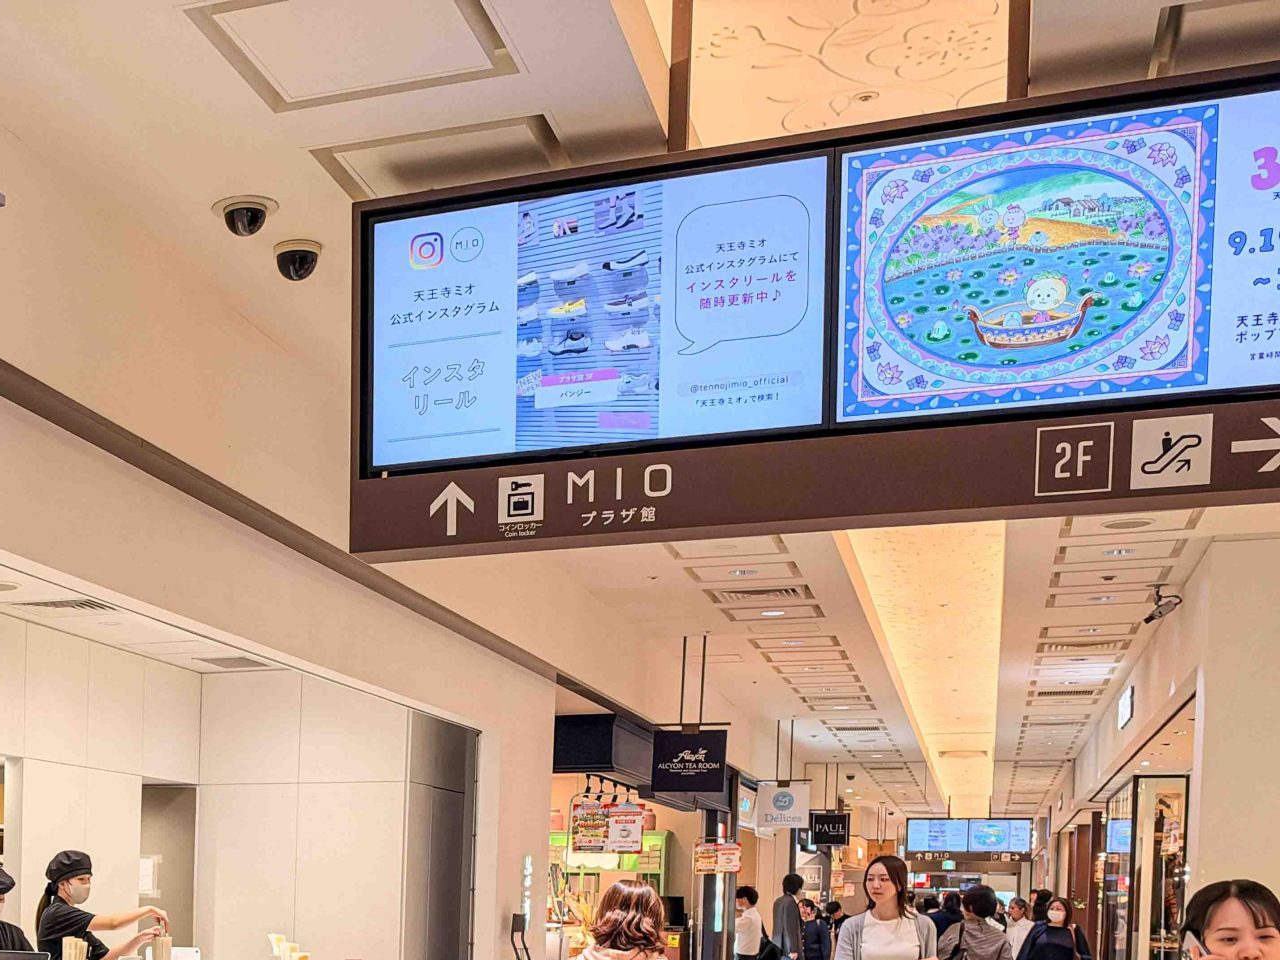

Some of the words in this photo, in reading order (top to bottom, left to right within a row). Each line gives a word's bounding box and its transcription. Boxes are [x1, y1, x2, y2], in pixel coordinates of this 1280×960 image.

[455, 239, 479, 250] MIO
[716, 238, 767, 254] 天王寺ミオ
[1228, 228, 1280, 256] 9.1
[685, 251, 799, 275] 公式インスタグラムにて
[413, 283, 476, 303] 天王寺ミオ
[686, 269, 797, 294] インスタリールを
[390, 300, 500, 326] 公式インスタグラム
[402, 358, 486, 389] インスタ
[689, 375, 789, 394] @tennojimio_official
[414, 390, 477, 416] リール
[1054, 440, 1094, 479] 2F
[567, 463, 673, 505] MIO
[498, 522, 543, 532] コインロッカー
[581, 506, 656, 527] プラザ館
[815, 823, 845, 833] PAUL
